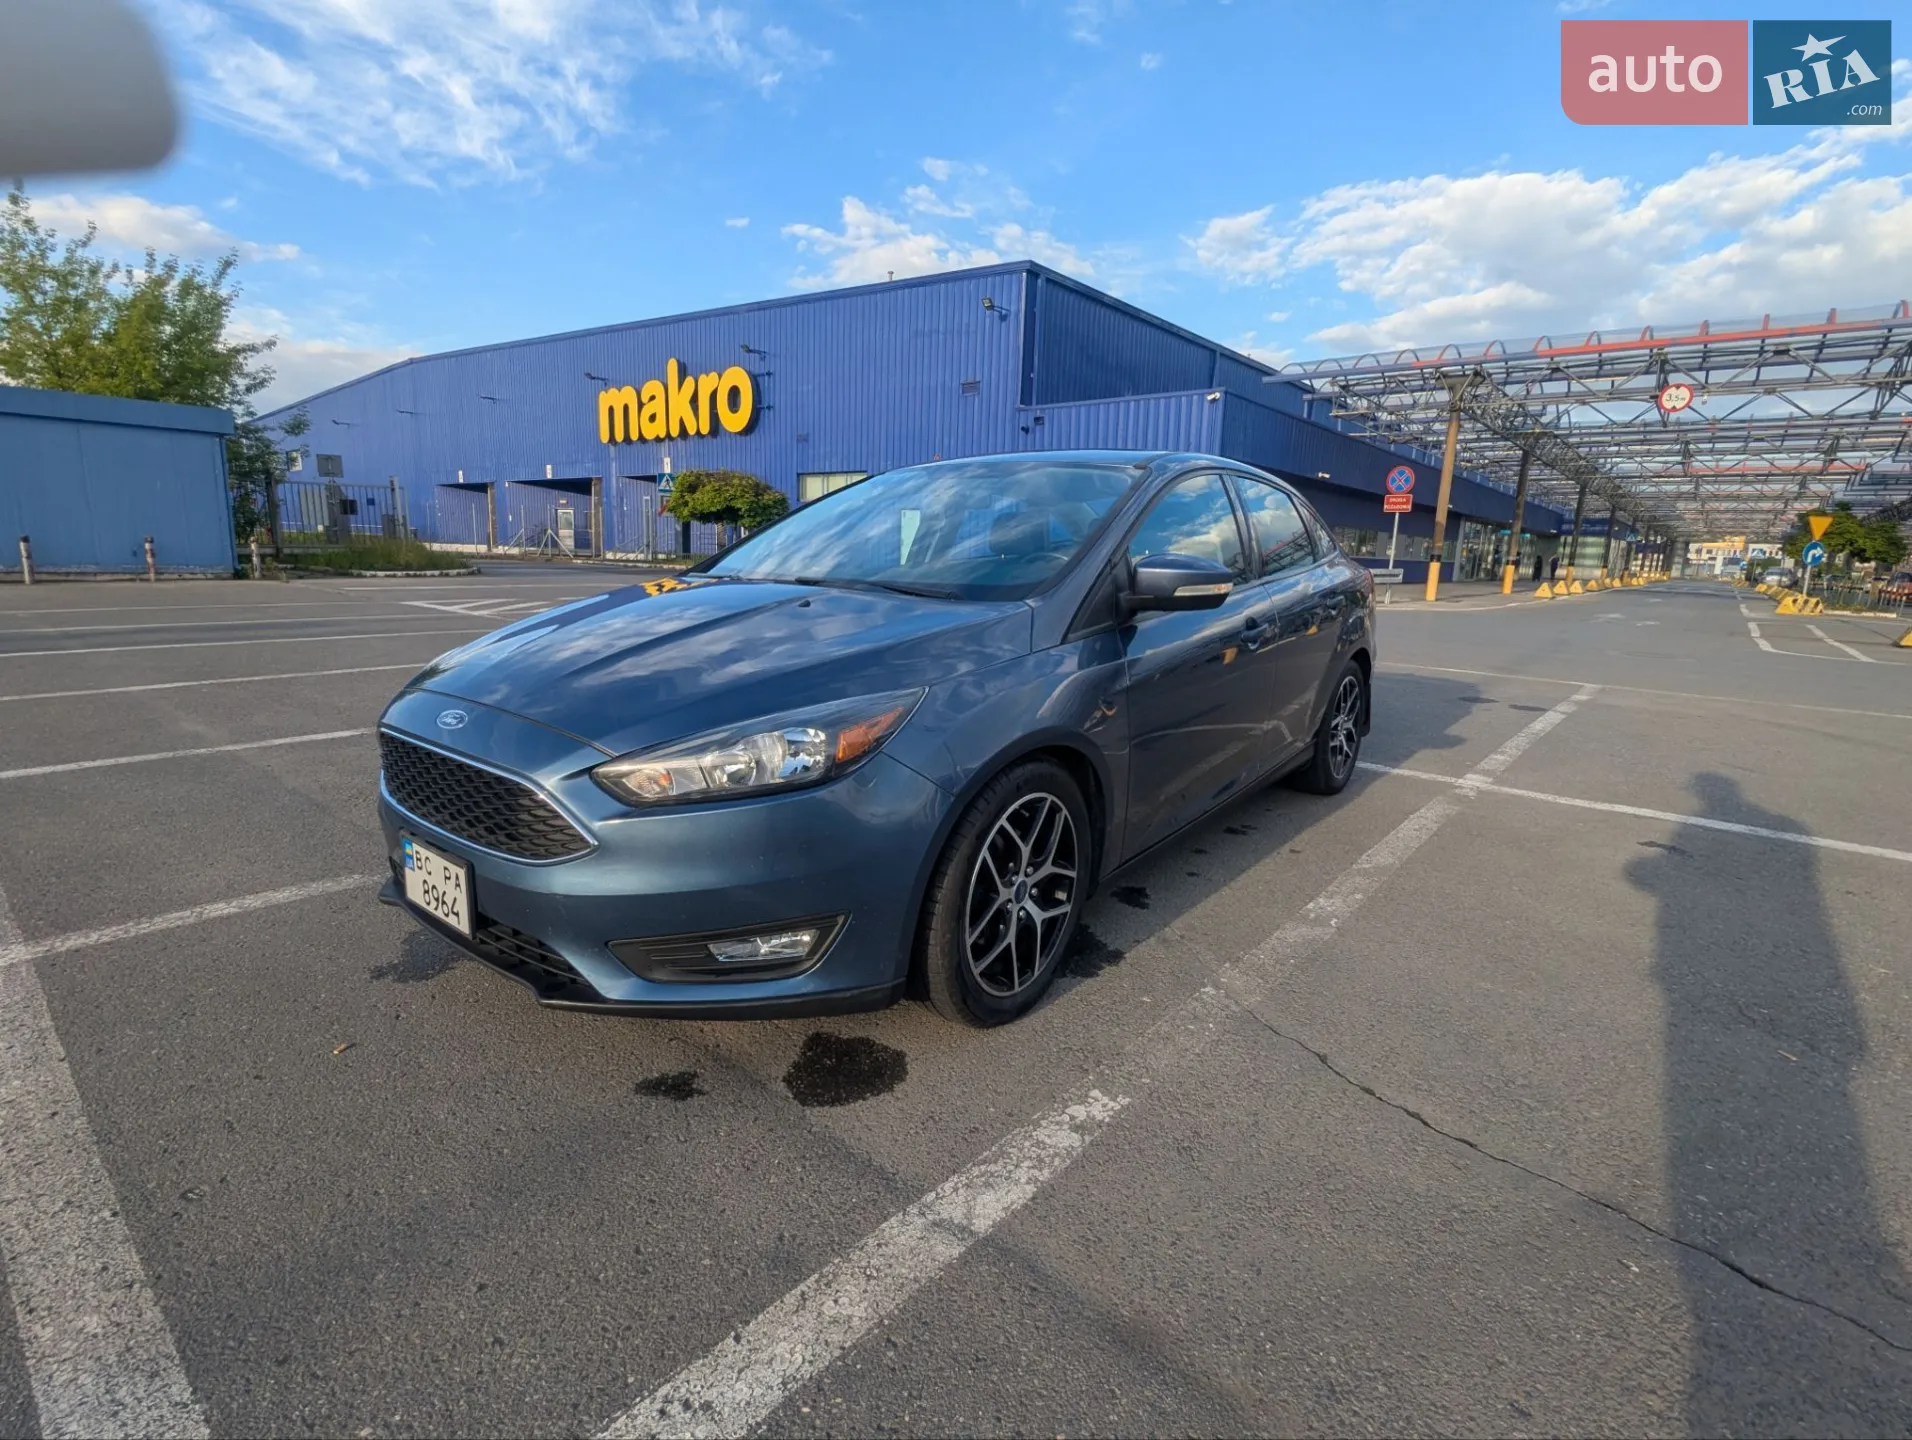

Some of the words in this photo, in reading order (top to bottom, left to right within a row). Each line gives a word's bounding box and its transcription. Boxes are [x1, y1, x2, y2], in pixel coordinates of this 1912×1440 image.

[598, 357, 753, 444] makro
[415, 850, 432, 876] BC
[443, 866, 462, 894] PA
[422, 879, 461, 925] 8964
